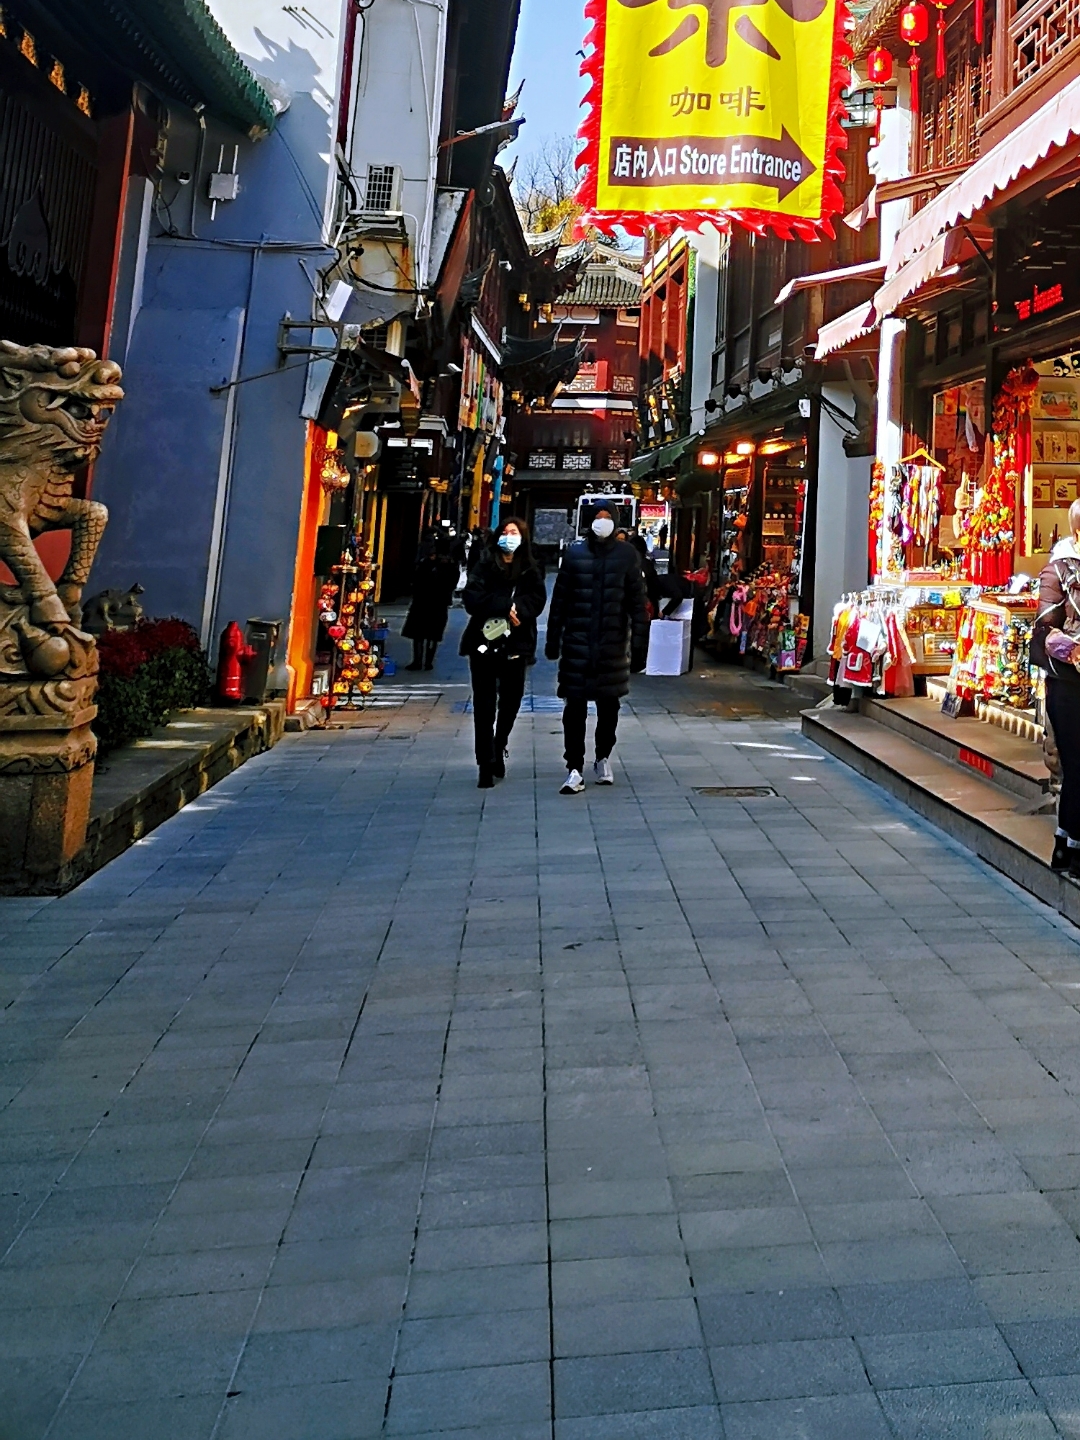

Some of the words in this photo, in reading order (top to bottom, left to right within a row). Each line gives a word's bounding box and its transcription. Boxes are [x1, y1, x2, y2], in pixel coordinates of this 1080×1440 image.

[669, 85, 766, 117] 咖啡
[613, 143, 677, 178] 店内入口
[679, 144, 727, 175] Store
[730, 144, 802, 182] Entrance
